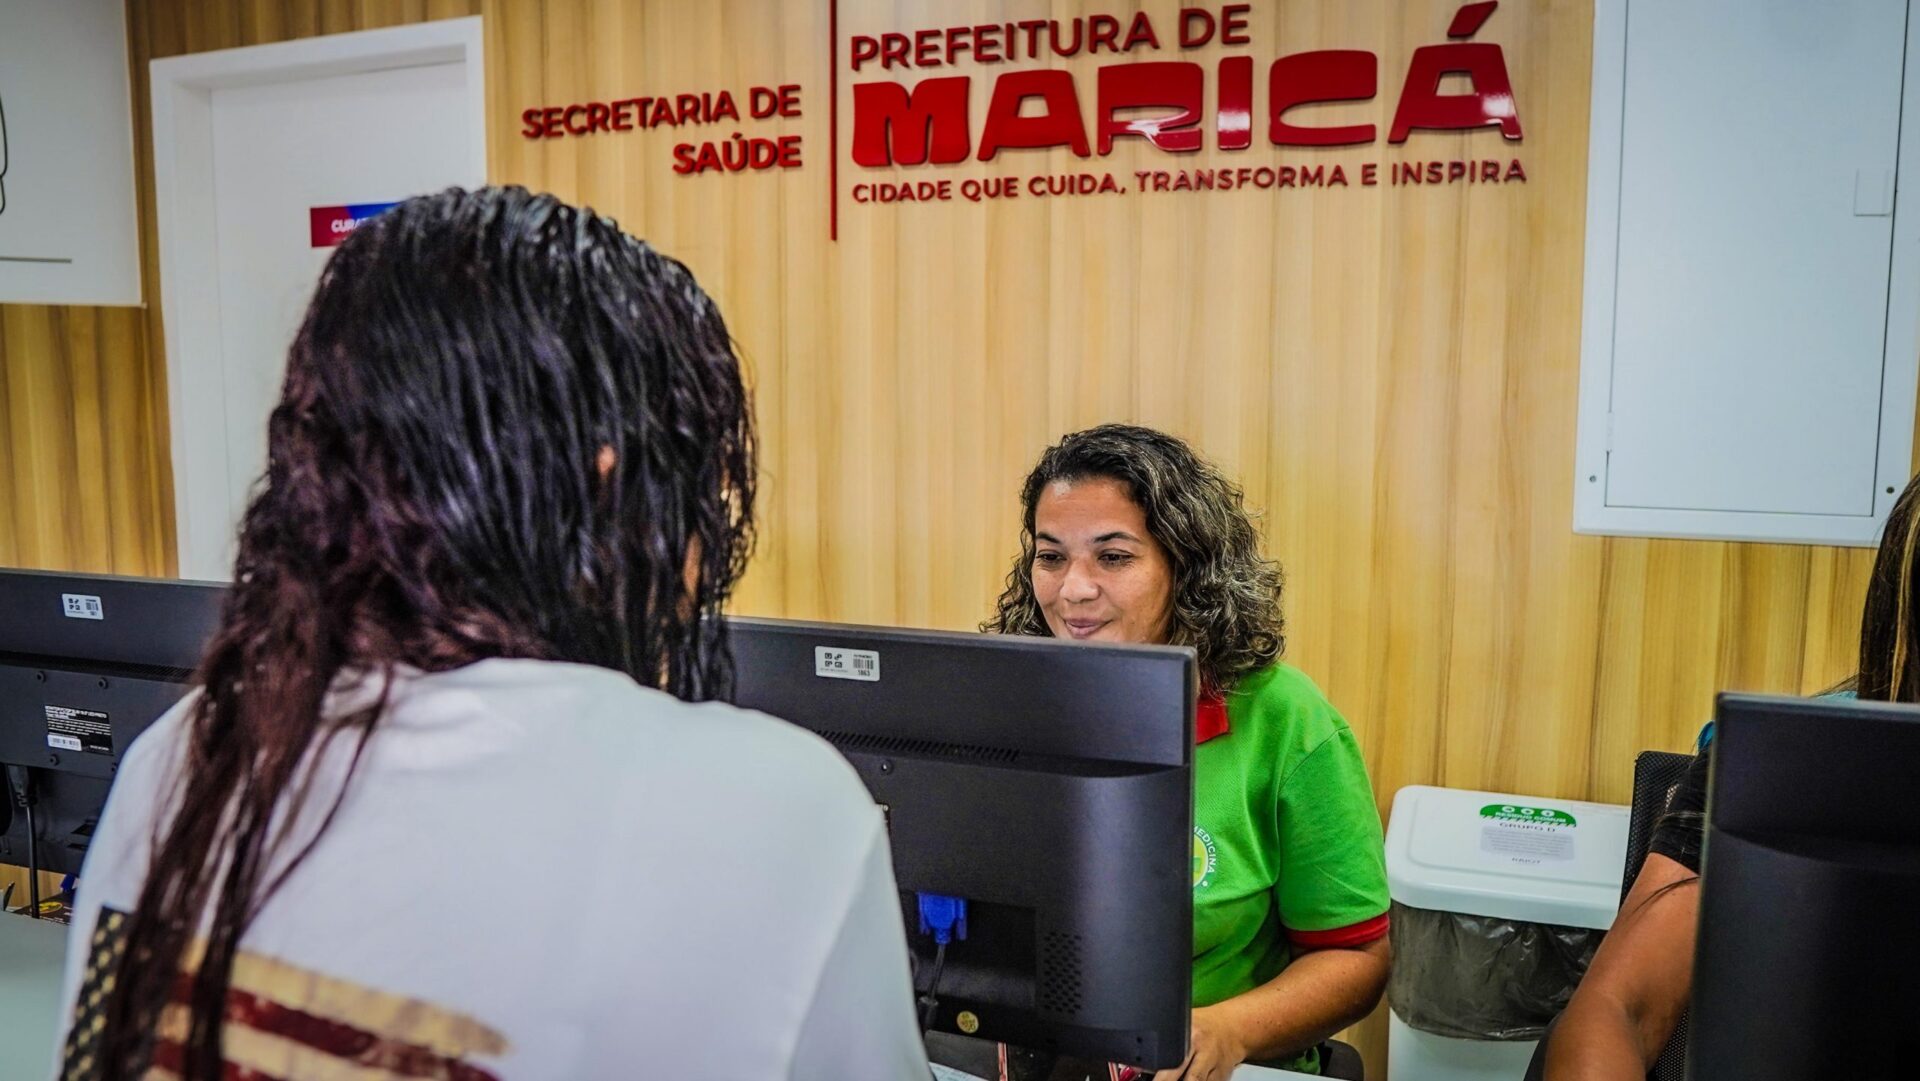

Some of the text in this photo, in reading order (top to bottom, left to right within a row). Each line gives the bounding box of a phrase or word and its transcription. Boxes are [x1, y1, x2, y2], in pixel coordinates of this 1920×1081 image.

[851, 4, 1250, 72] PREFEITURA DE
[852, 0, 1523, 167] MARICÁ
[522, 84, 802, 139] SECRETARIA DE
[672, 132, 802, 175] SAÚDE
[852, 159, 1526, 203] CIDADE QUE CUIDA, TRANSFORMA E INSPIRA
[1499, 822, 1544, 831] GRUPO
